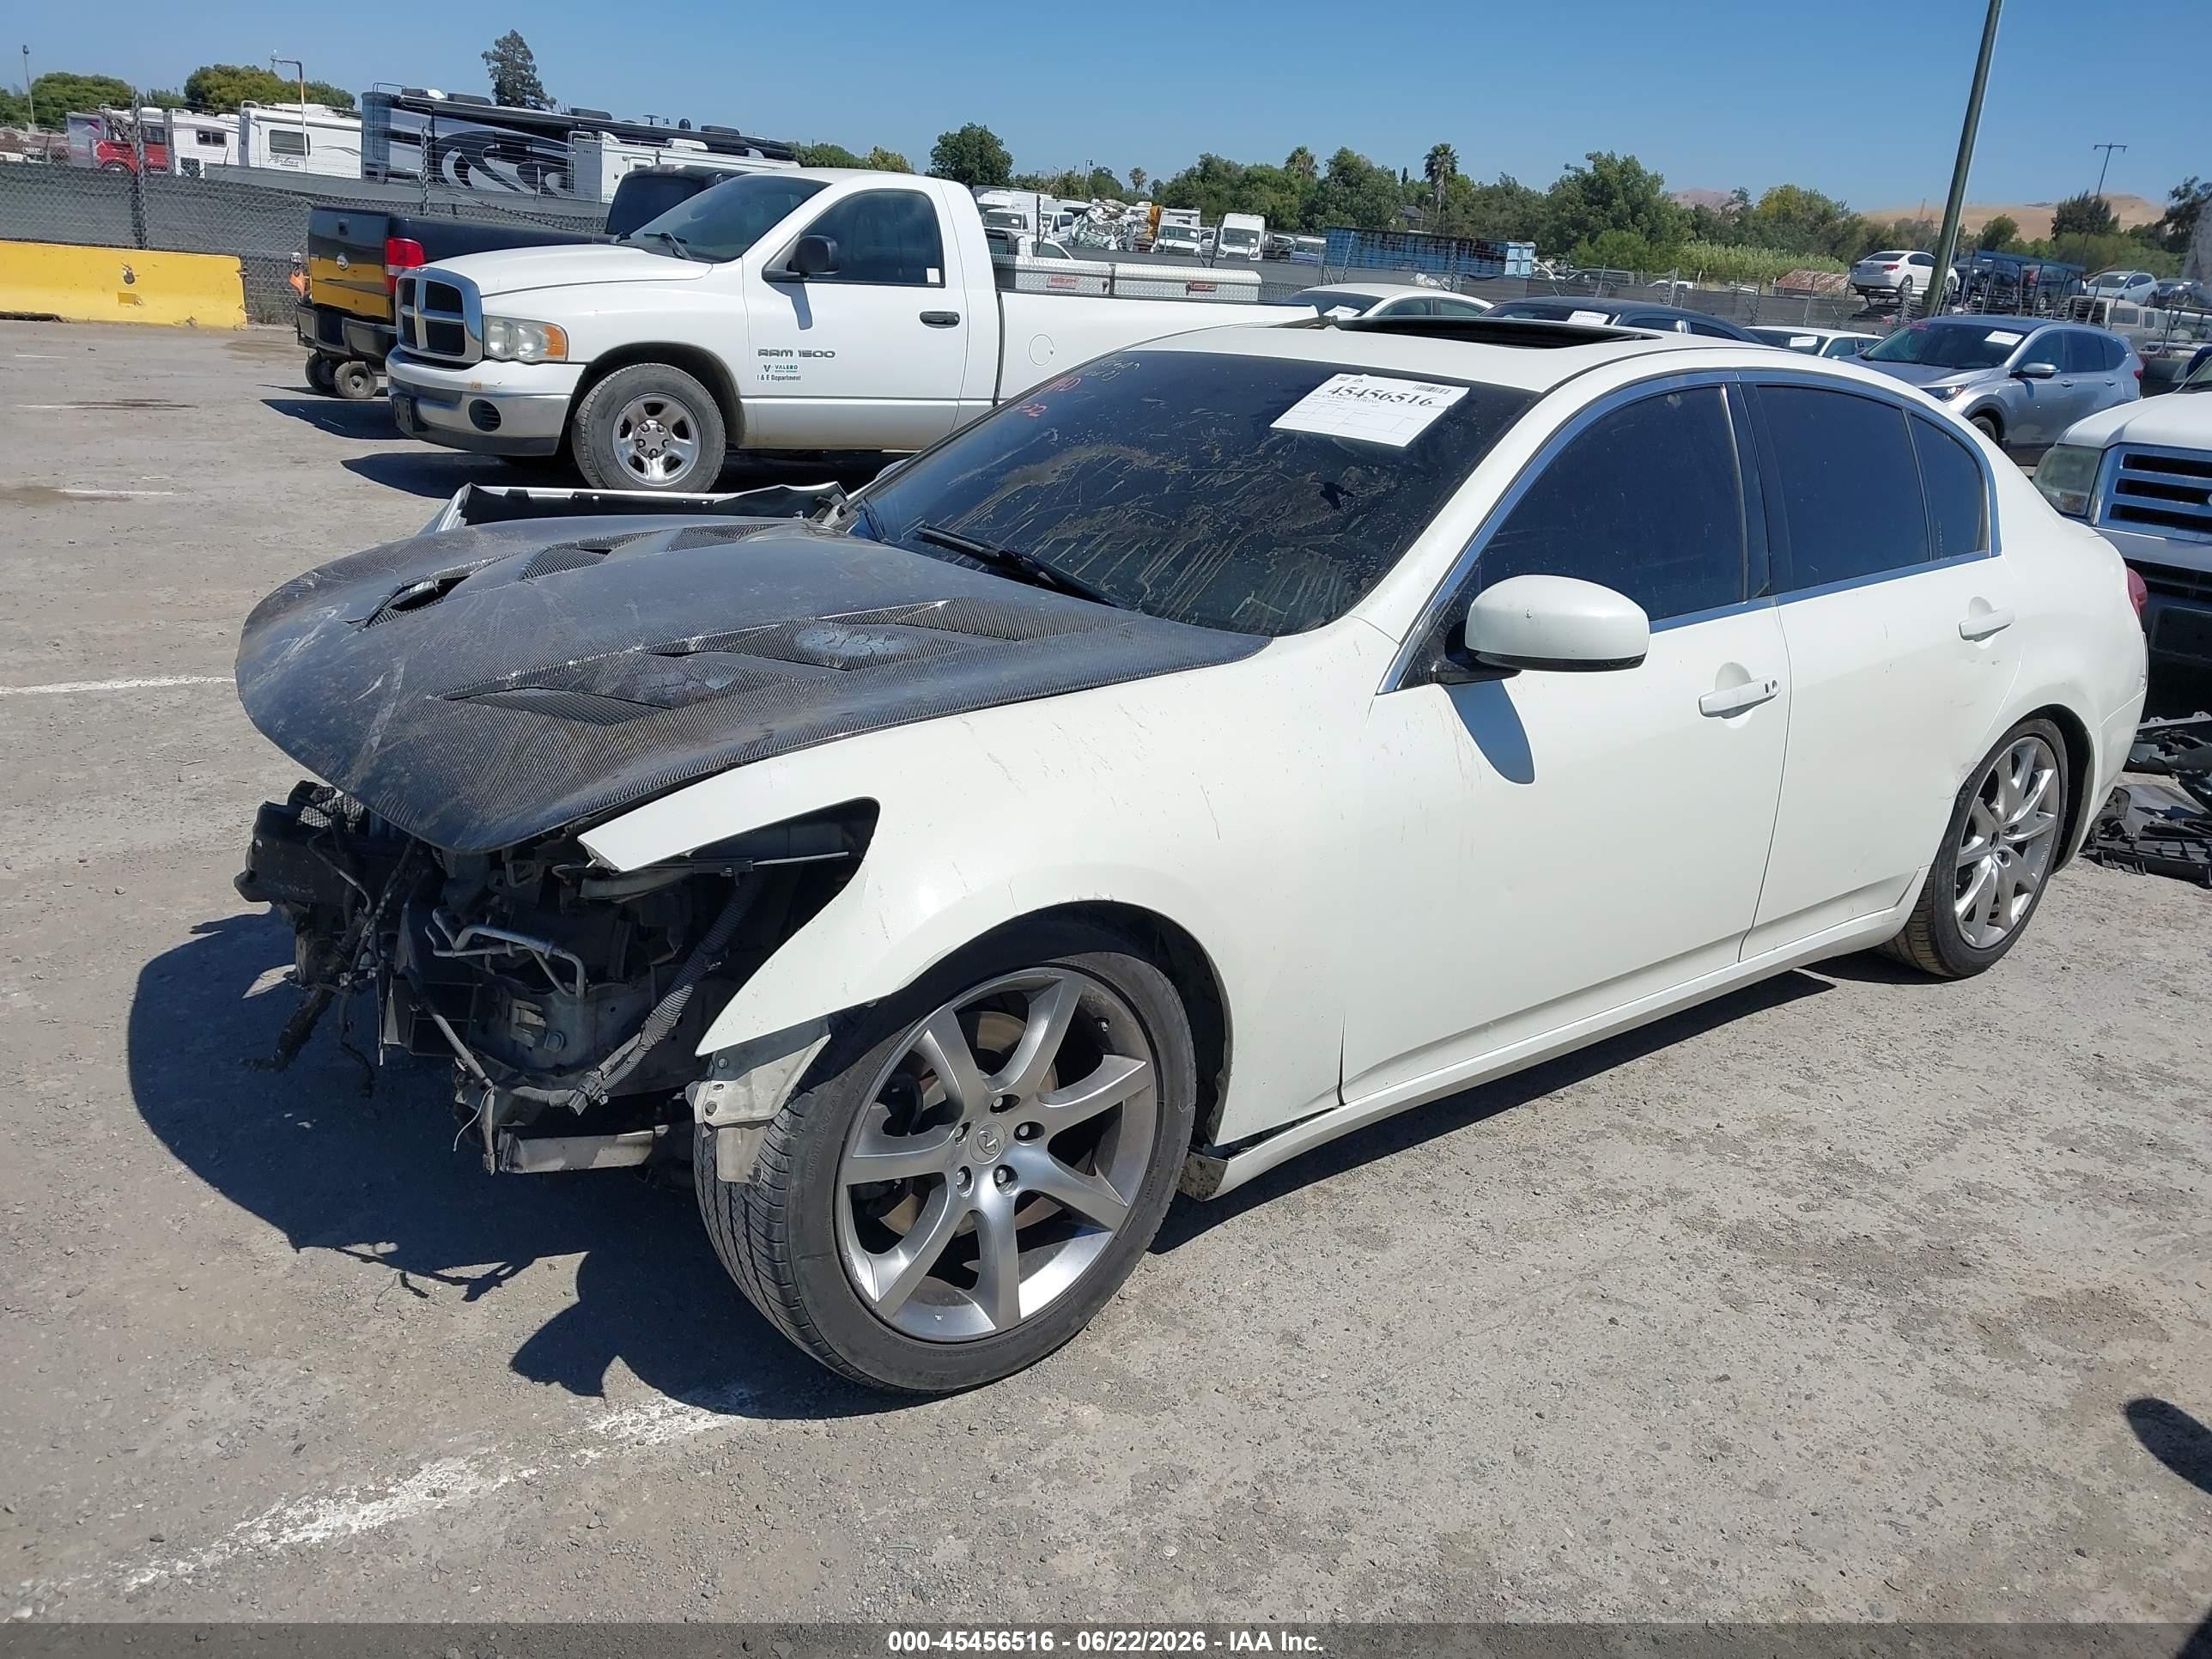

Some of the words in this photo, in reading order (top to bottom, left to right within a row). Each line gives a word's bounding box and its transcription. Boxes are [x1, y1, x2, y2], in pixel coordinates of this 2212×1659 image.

[757, 349, 793, 357] RAM
[797, 349, 836, 358] 1500
[1328, 386, 1438, 406] 45456516
